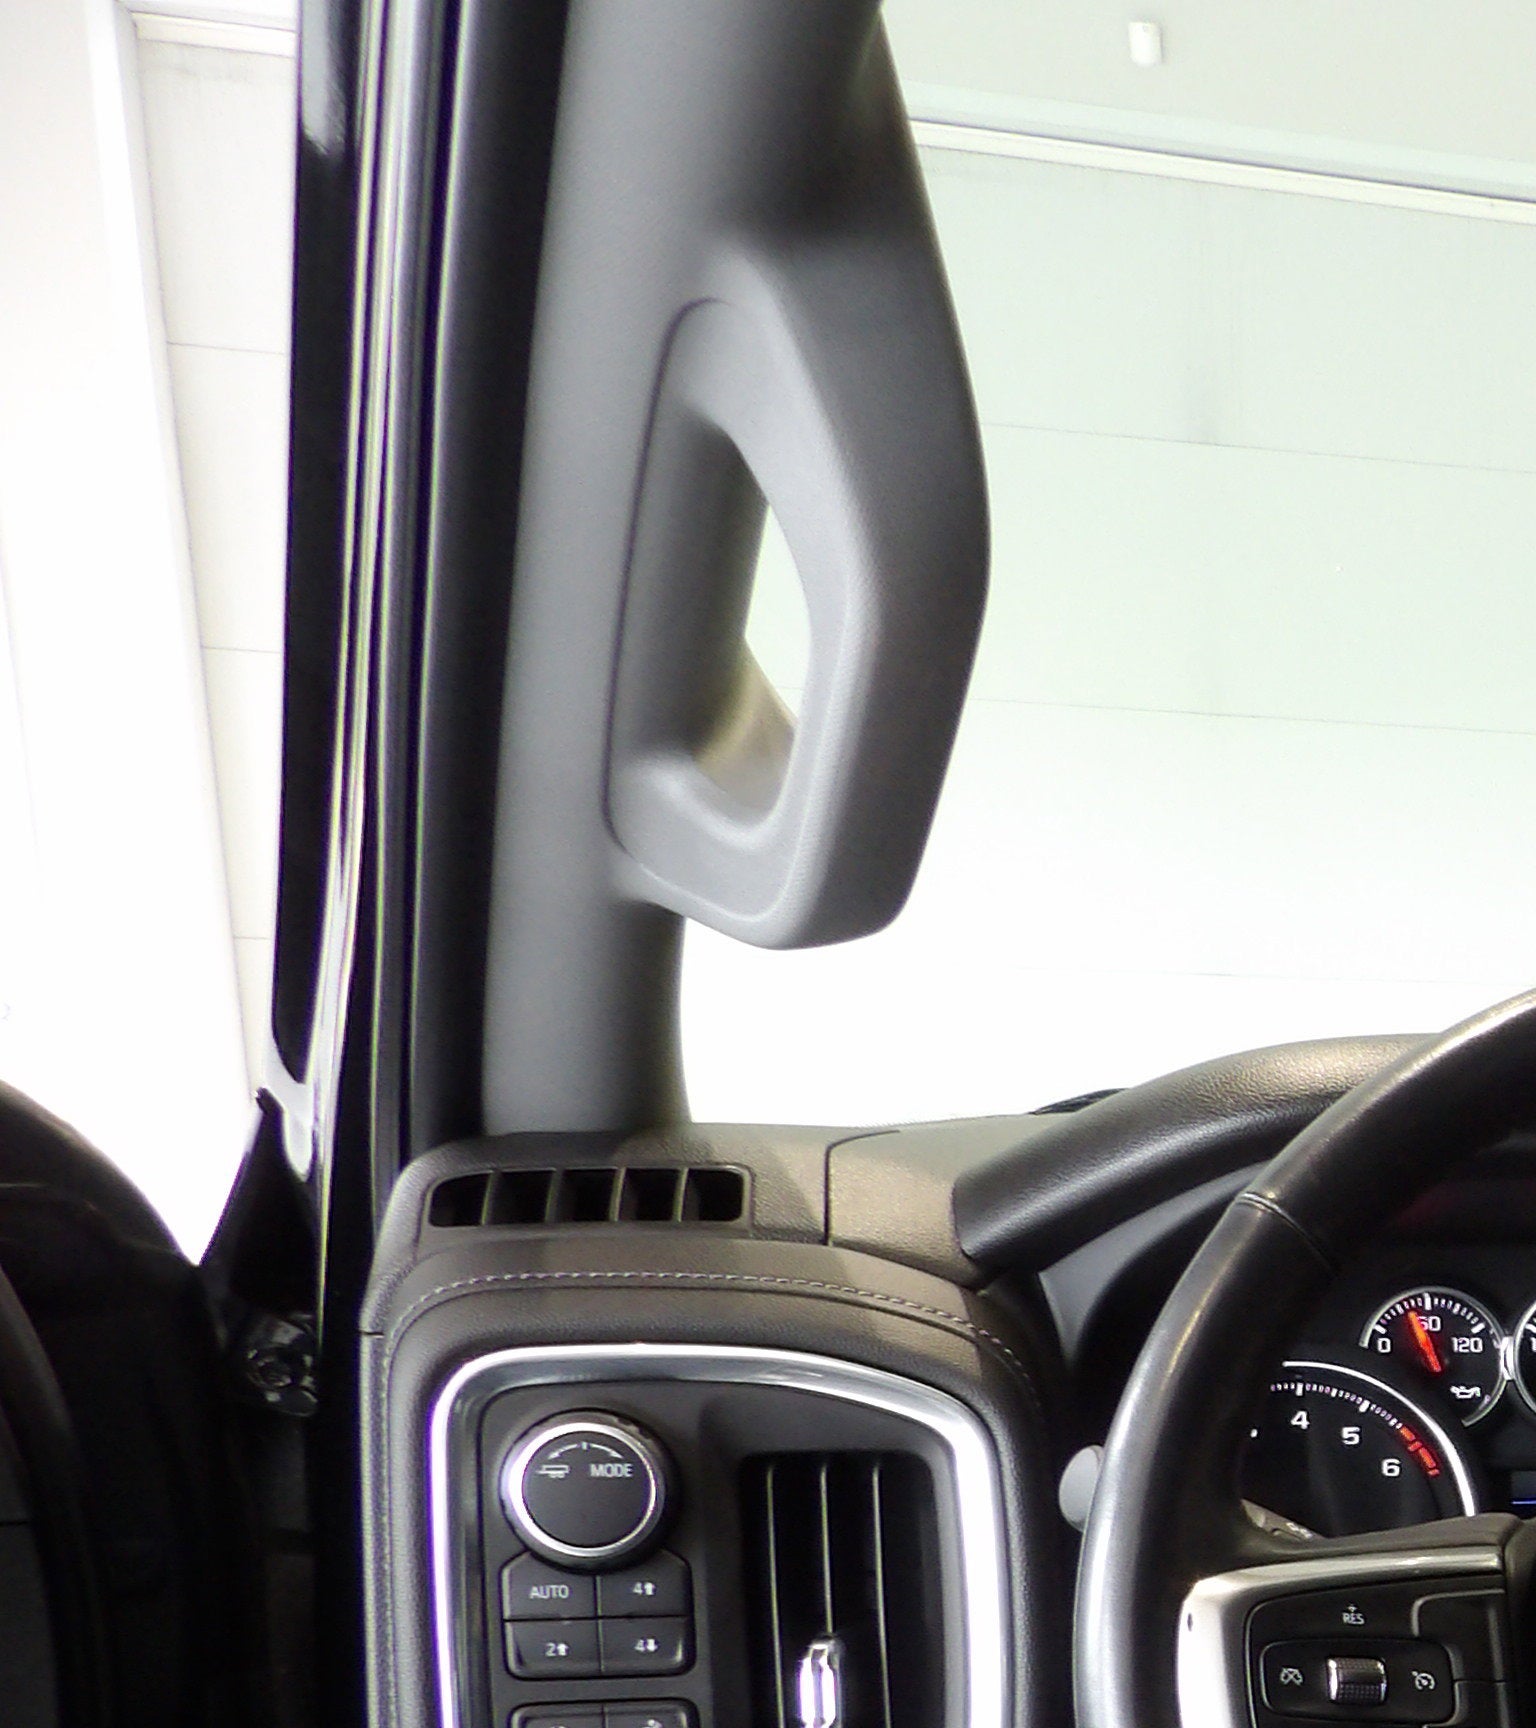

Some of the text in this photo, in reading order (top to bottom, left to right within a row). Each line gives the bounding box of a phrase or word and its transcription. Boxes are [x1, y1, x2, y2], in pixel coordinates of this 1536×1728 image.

[1377, 1337, 1391, 1353] 0
[1452, 1337, 1483, 1353] 120
[1290, 1410, 1311, 1430] 4
[1341, 1427, 1361, 1445] 5
[590, 1463, 634, 1478] MODE
[1381, 1458, 1401, 1477] 6
[529, 1585, 569, 1599] AUTO
[632, 1582, 643, 1595] 4
[1342, 1612, 1366, 1626] RES
[545, 1643, 556, 1657] 2
[635, 1639, 645, 1652] 4
